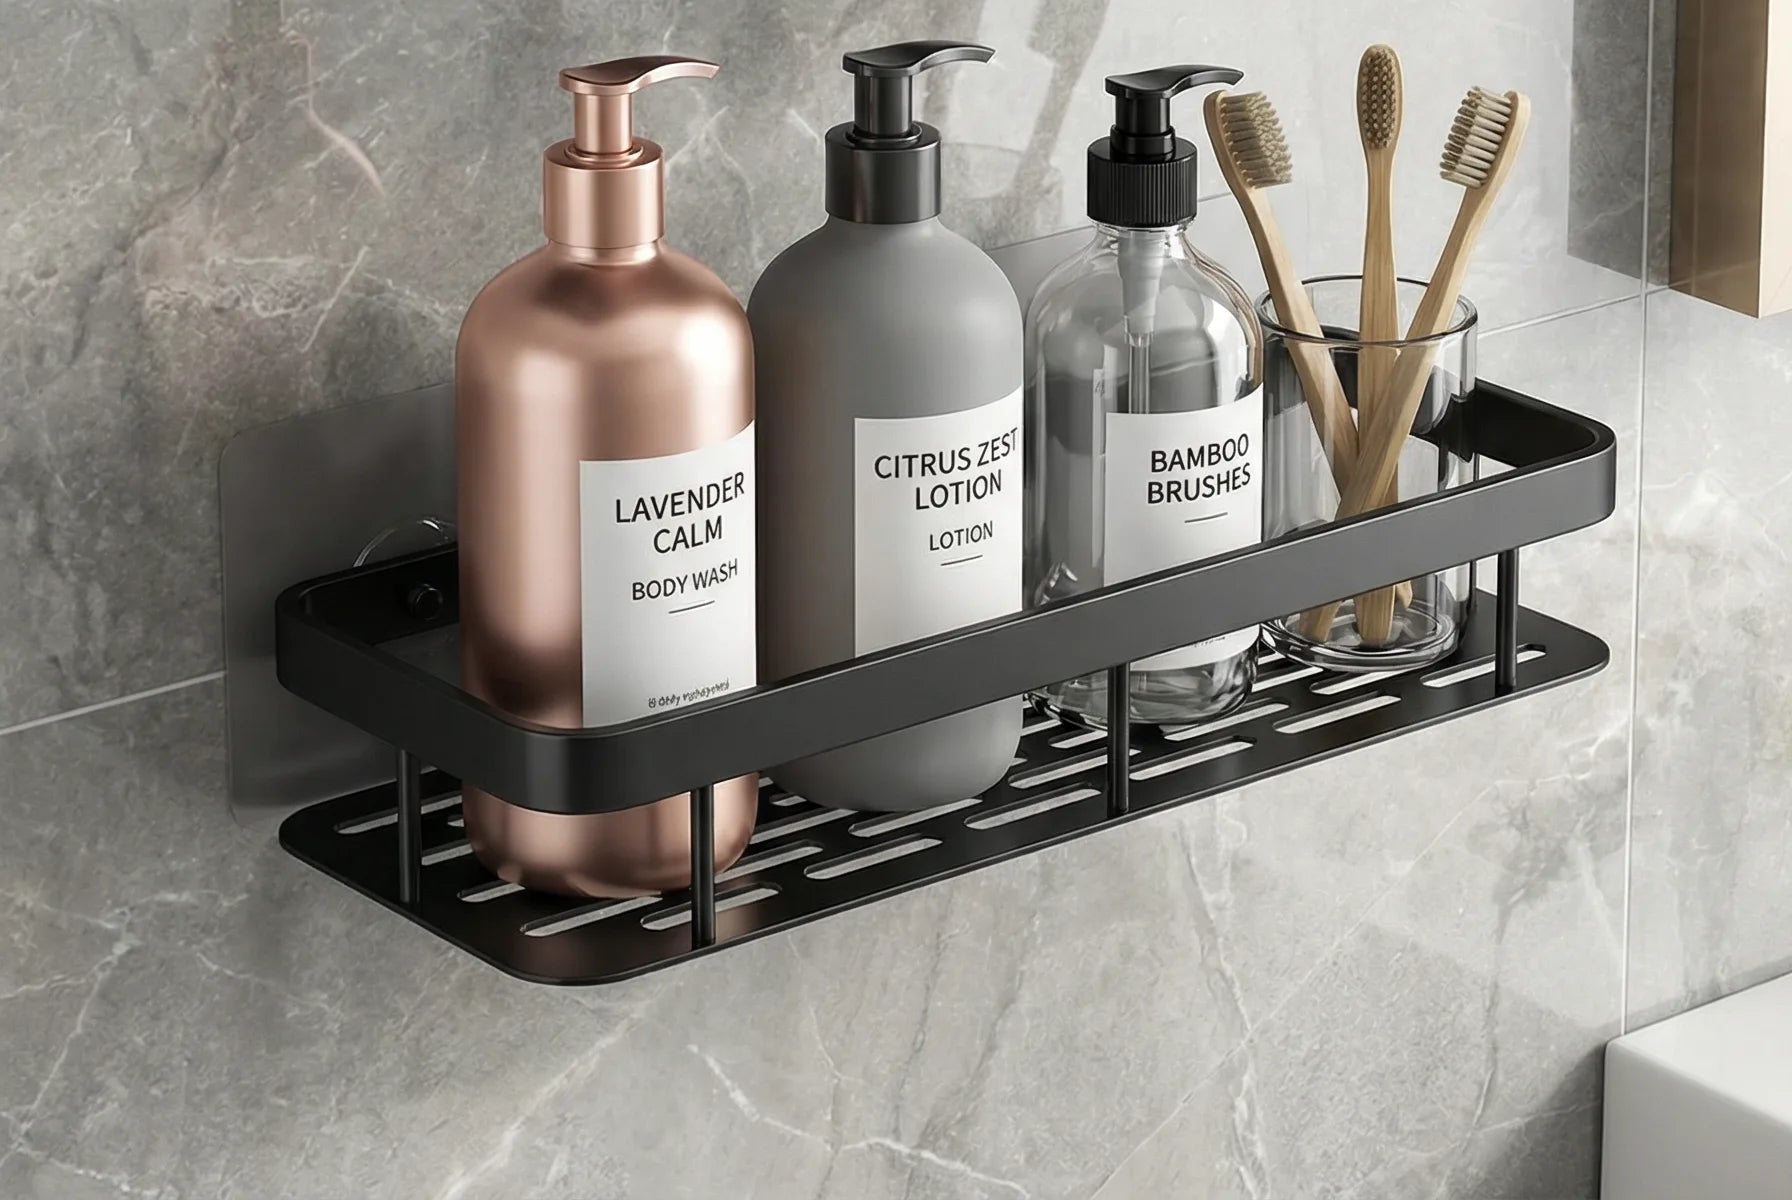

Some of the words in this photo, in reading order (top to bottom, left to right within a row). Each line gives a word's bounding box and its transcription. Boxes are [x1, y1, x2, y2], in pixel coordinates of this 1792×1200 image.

[874, 447, 972, 479] CITRUS
[977, 427, 1018, 467] ZEST
[1151, 433, 1249, 473] BAMBOO
[616, 471, 745, 523] LAVENDER
[915, 469, 1002, 510] LOTION
[1147, 462, 1251, 504] BRUSHES
[653, 515, 722, 554] CALM
[929, 520, 993, 551] LOTION
[632, 574, 688, 600] BODY
[692, 558, 738, 590] WASH
